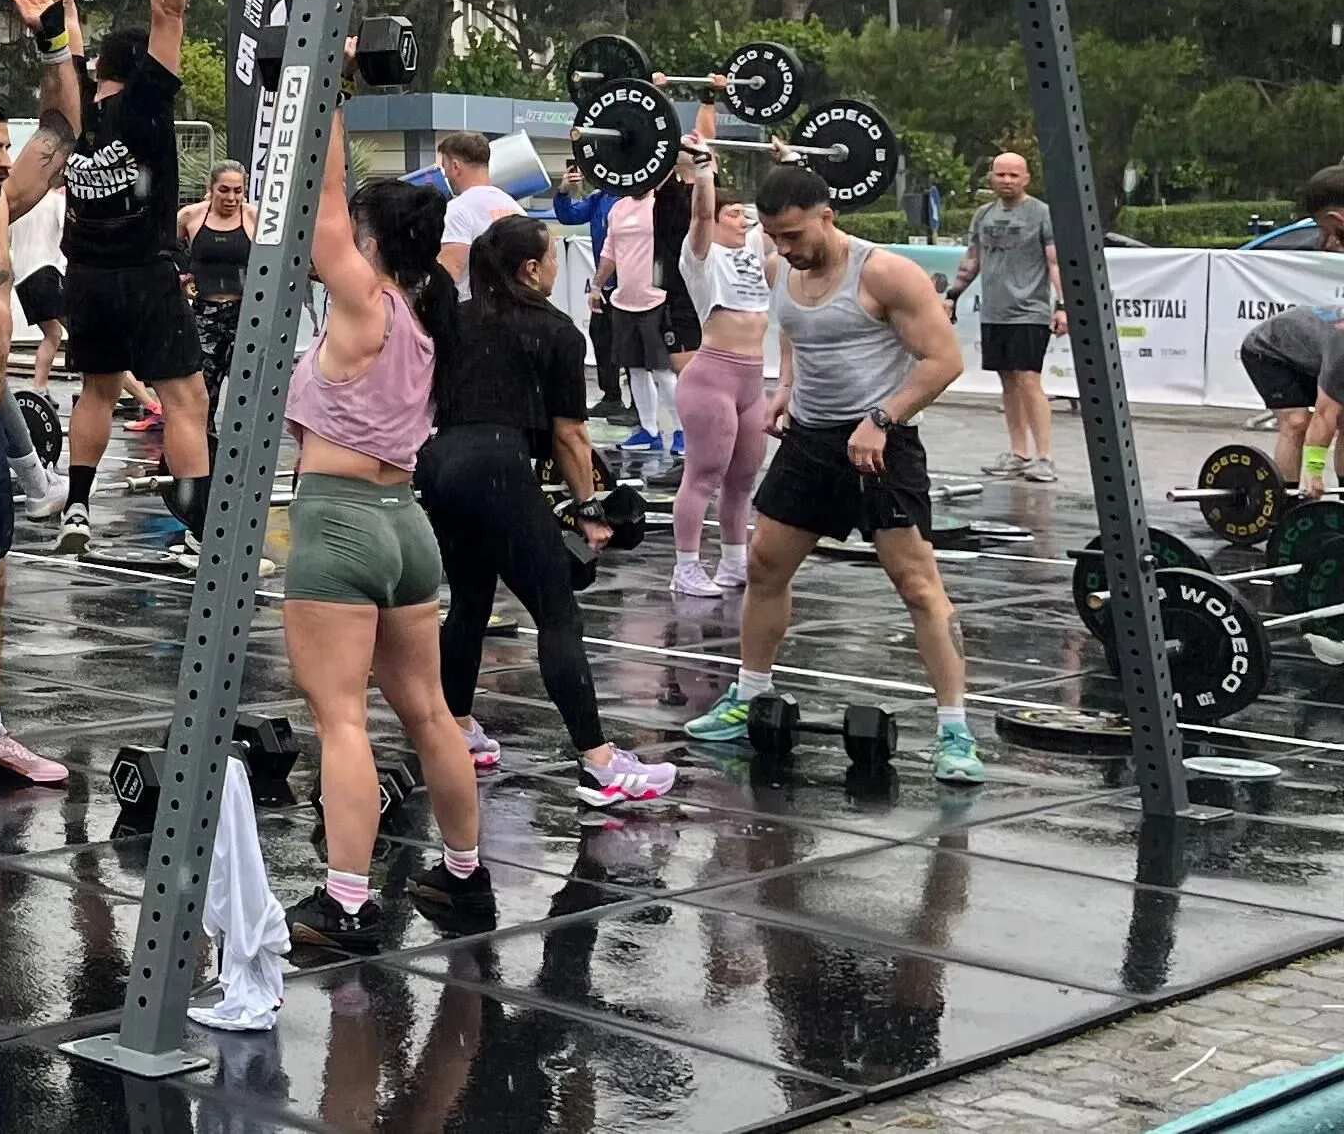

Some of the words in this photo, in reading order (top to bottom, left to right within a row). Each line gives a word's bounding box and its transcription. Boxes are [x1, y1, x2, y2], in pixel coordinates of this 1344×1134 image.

[262, 76, 302, 236] WODECO
[801, 108, 883, 141] WODECO
[828, 170, 882, 200] WODE
[1179, 583, 1249, 694] WODECO
